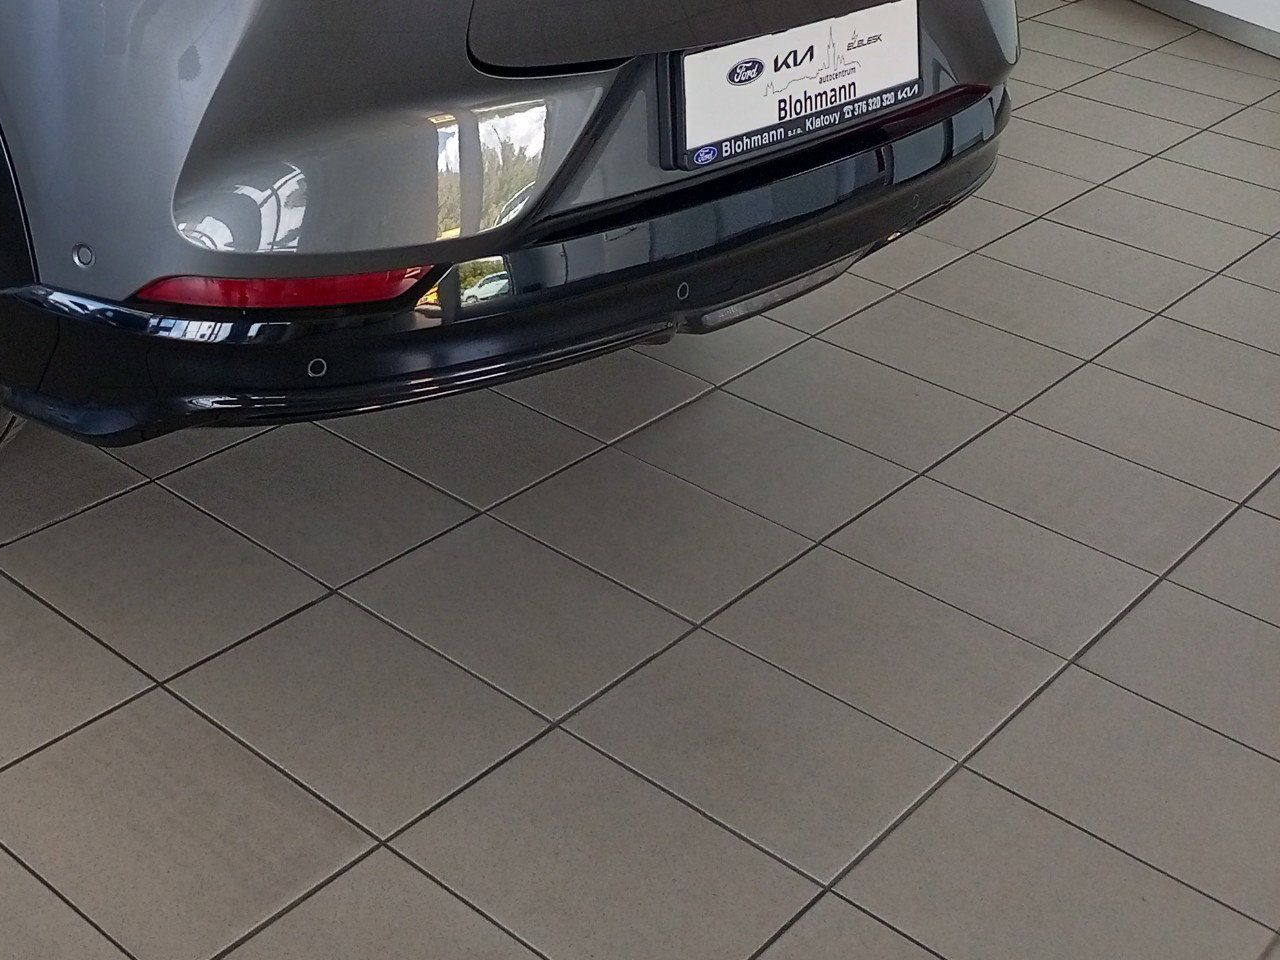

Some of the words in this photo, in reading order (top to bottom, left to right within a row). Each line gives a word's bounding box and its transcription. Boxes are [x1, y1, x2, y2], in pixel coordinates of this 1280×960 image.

[846, 33, 883, 51] ELBLESK
[773, 44, 815, 73] KIA
[730, 60, 763, 85] Ford
[818, 66, 857, 85] autocentrum
[777, 81, 857, 122] Blohmann
[696, 148, 715, 163] Ford
[722, 128, 785, 158] Blohmann
[805, 111, 841, 132] Klatovy
[853, 101, 867, 116] 376
[867, 96, 881, 111] 320
[881, 92, 895, 107] 320
[897, 84, 919, 101] KIA
